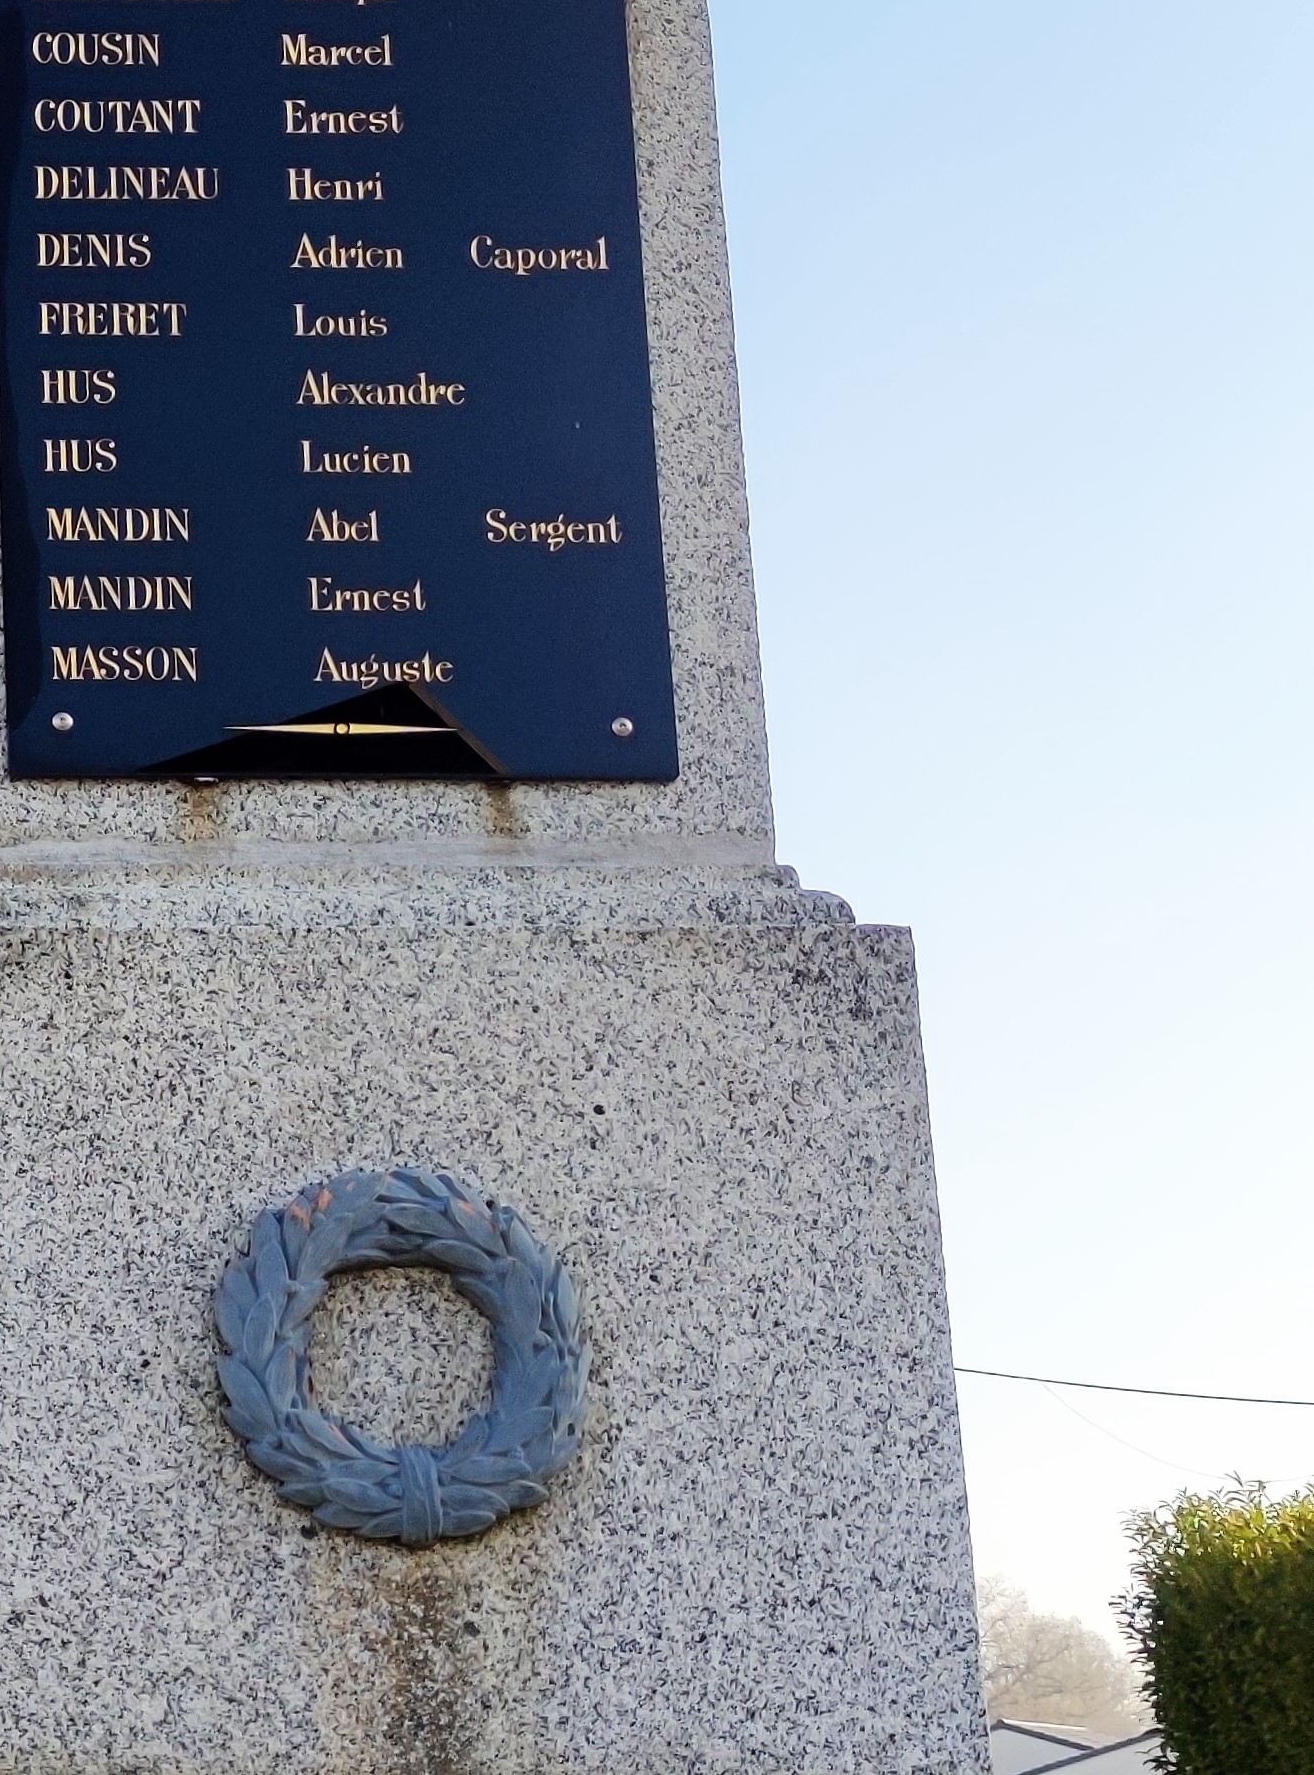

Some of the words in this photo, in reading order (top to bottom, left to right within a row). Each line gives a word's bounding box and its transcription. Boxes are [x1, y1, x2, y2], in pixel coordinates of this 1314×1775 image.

[32, 32, 160, 67] COUSIN
[280, 33, 394, 66] Marcel
[34, 99, 201, 135] COUTANT
[283, 99, 404, 134] Ernest
[34, 165, 219, 200] DELINEAU
[286, 167, 383, 201] Henri
[36, 233, 152, 268] DENIS
[289, 232, 404, 269] Adrien
[470, 235, 610, 276] Caporal
[38, 302, 187, 336] FRERET
[292, 303, 388, 337] Louis
[40, 369, 116, 404] HUS
[295, 368, 466, 406] Alexandre
[43, 438, 117, 472] HUS
[300, 440, 412, 474] Lucien
[45, 505, 189, 542] MANDIN
[305, 507, 380, 542] Abel
[485, 508, 623, 552] Sergent
[47, 574, 193, 611] MANDIN
[307, 577, 427, 612] Ernest
[50, 644, 198, 683] MASSON
[313, 646, 454, 690] Auguste
